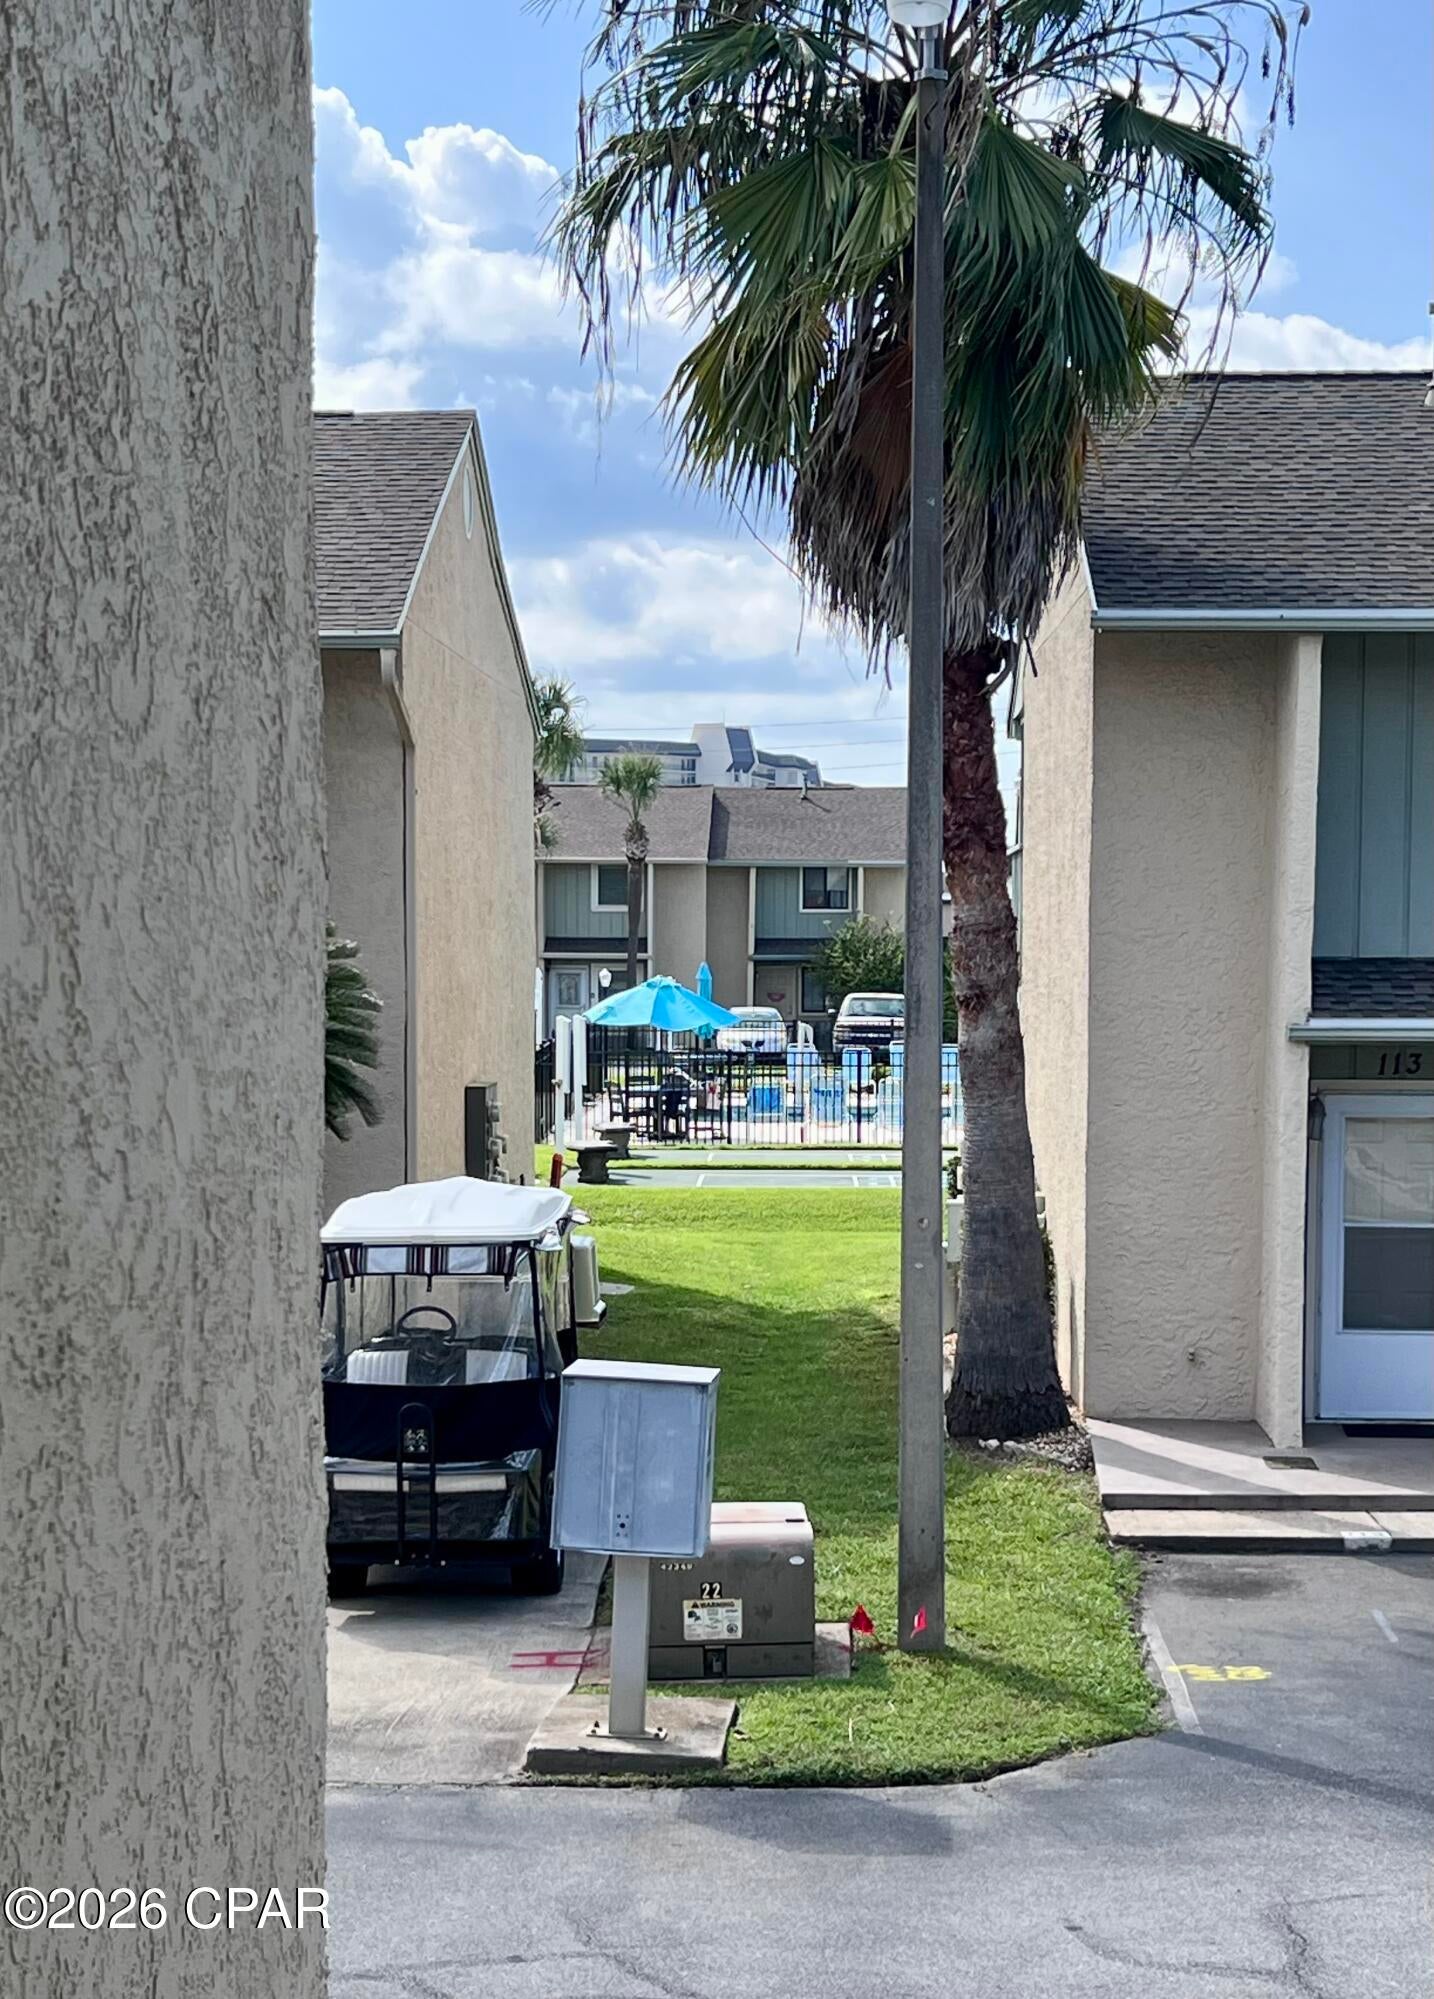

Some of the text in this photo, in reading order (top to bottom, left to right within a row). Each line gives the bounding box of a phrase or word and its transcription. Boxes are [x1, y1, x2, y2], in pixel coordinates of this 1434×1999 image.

[1377, 1052, 1423, 1076] 113
[701, 1582, 721, 1599] 22
[700, 1601, 735, 1609] WARNING
